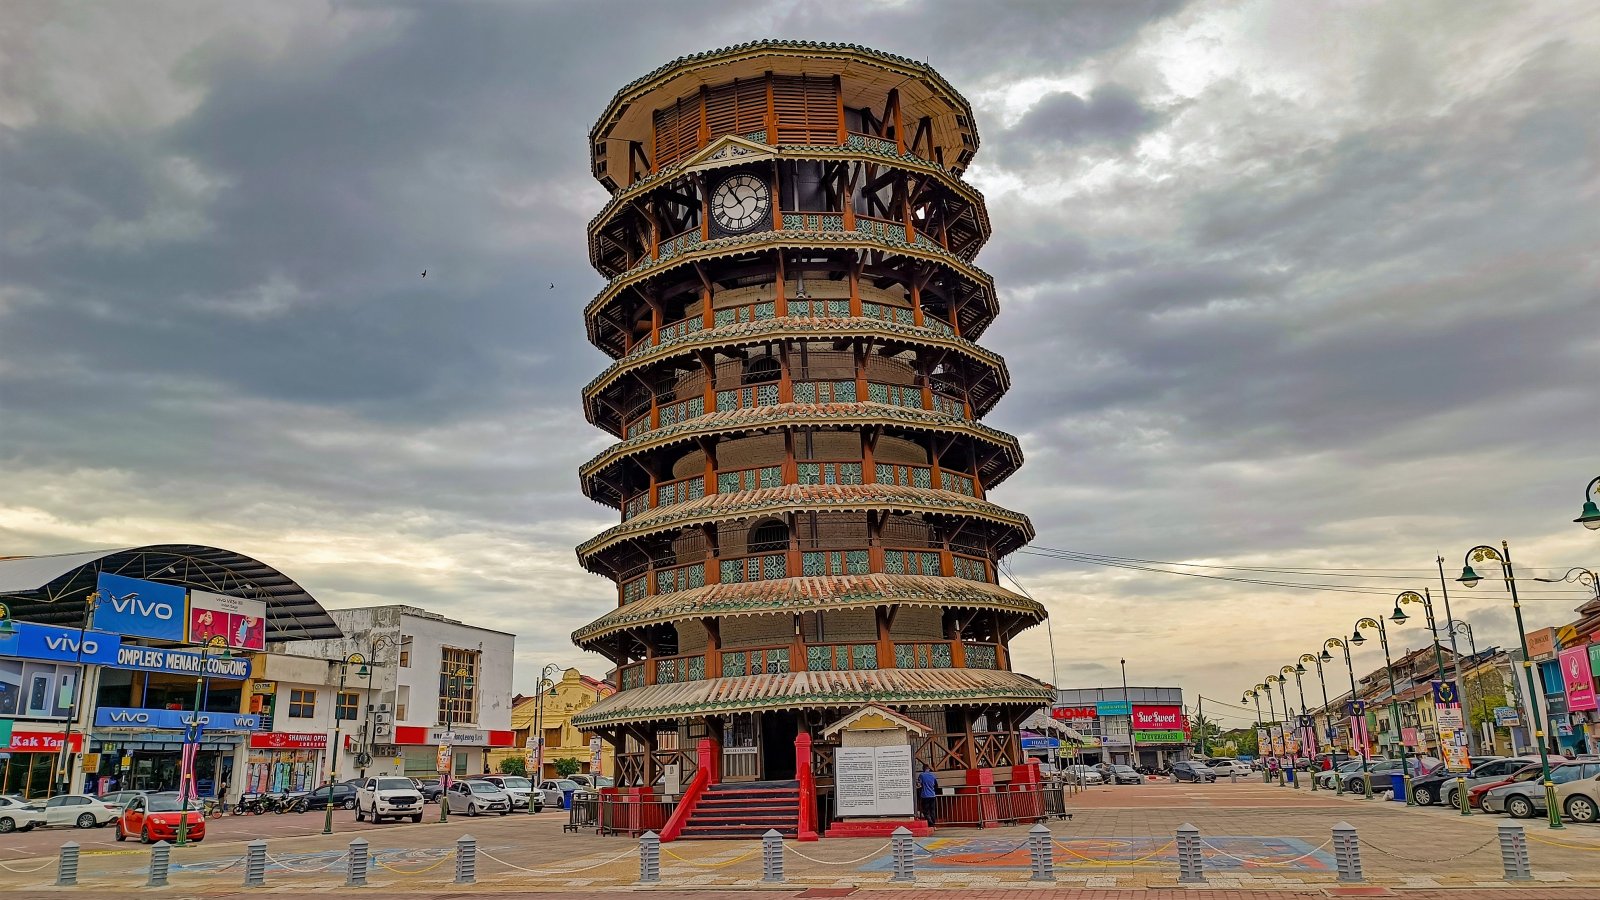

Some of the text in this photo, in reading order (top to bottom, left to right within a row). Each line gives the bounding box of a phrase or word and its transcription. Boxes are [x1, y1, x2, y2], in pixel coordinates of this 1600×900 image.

[111, 593, 173, 620] vivo
[45, 633, 98, 654] vivo
[207, 658, 248, 676] CONDONG
[110, 710, 149, 723] vivo
[234, 715, 255, 727] vivo
[1137, 711, 1176, 723] Sue Sweet
[11, 736, 39, 747] Kak
